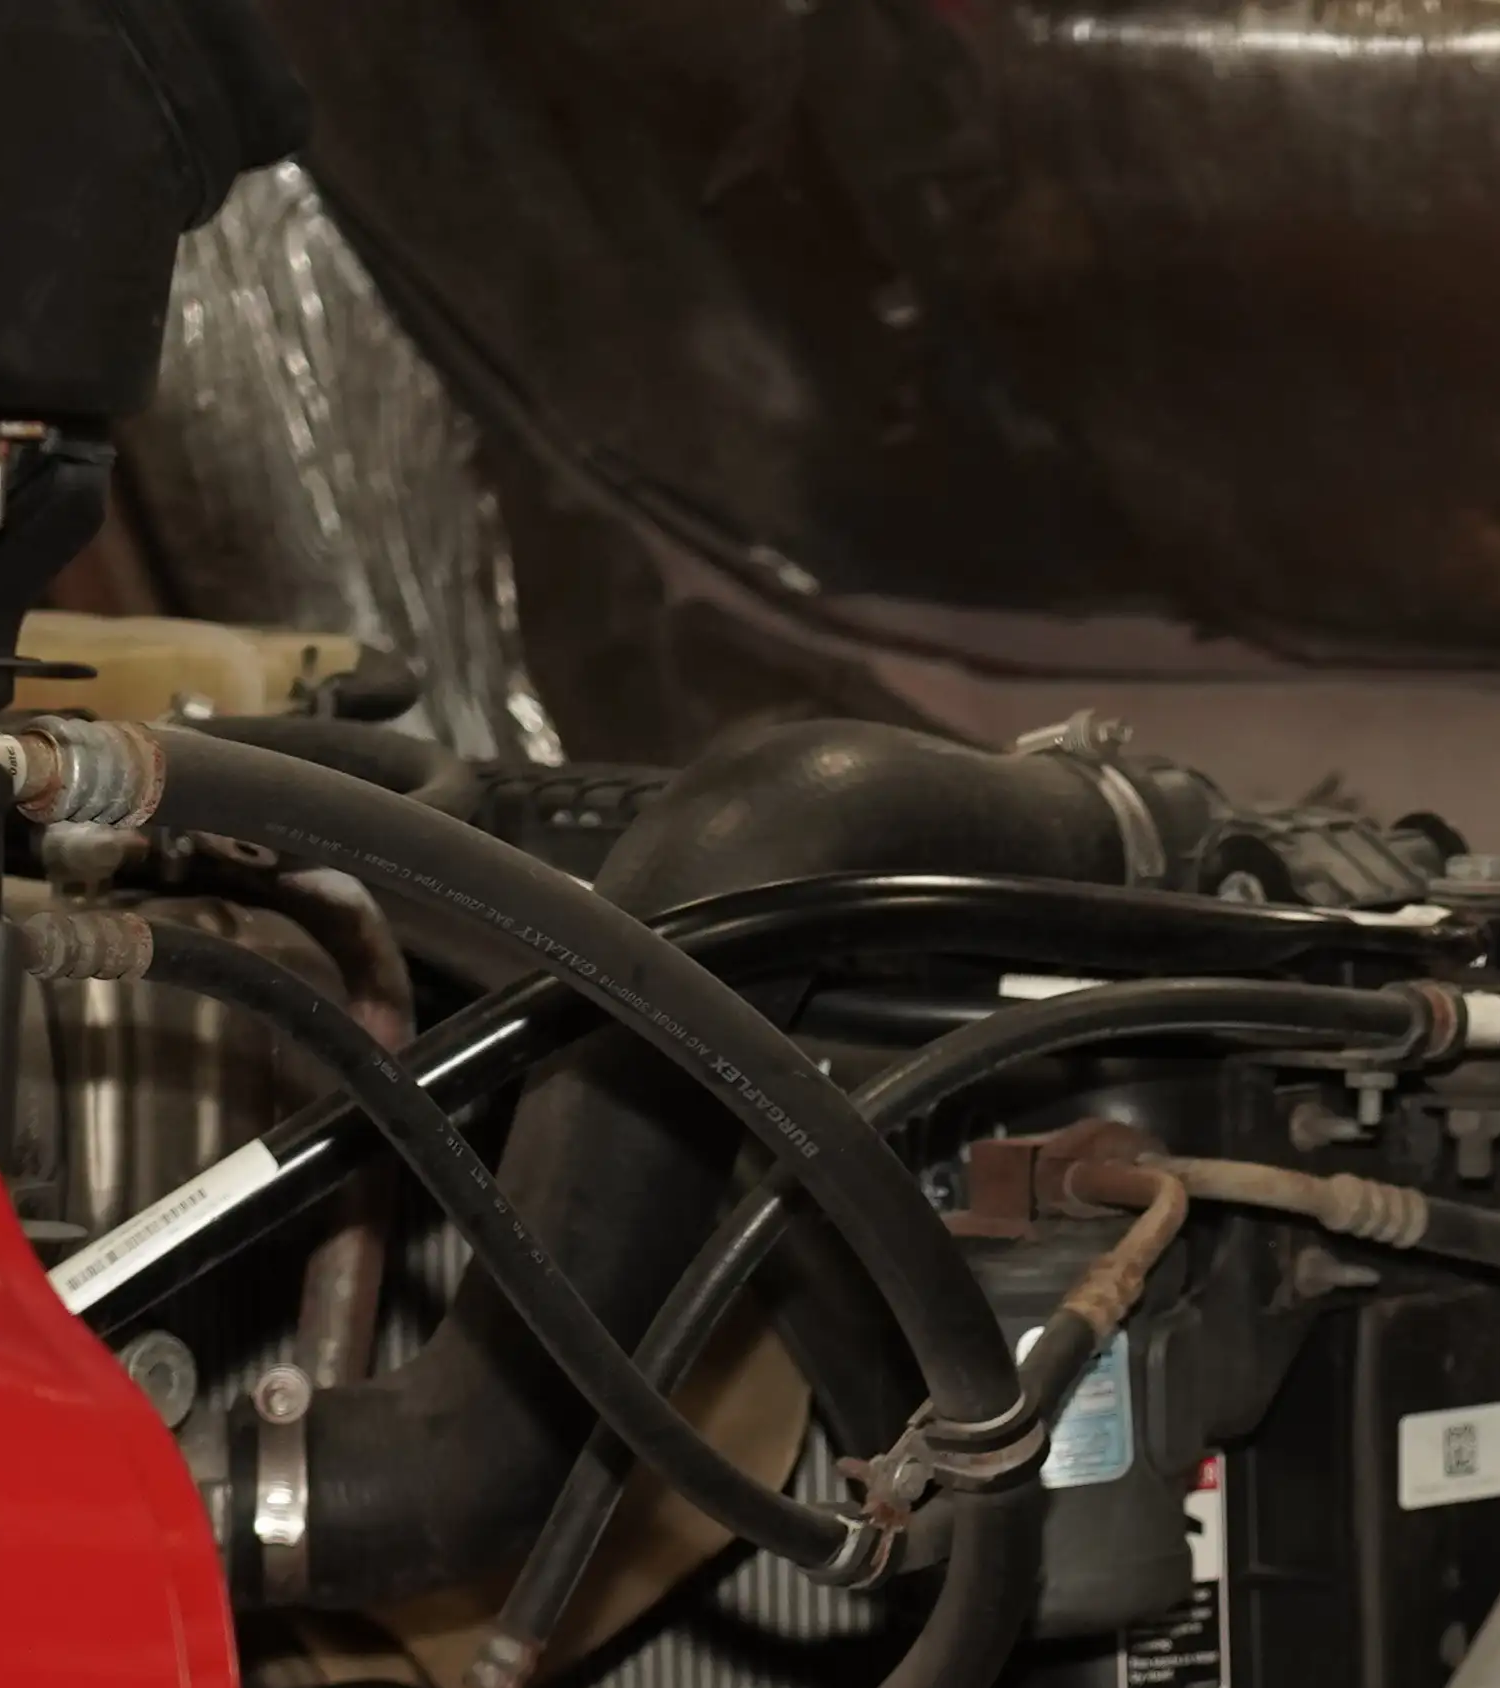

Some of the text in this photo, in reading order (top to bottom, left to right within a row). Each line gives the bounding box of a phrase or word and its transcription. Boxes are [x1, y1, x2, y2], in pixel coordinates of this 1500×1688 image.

[364, 852, 399, 874] Class
[414, 873, 445, 894] Type
[485, 907, 515, 930] SAE
[514, 925, 598, 976] GALAXY
[653, 1010, 688, 1039] HOSE
[709, 1055, 820, 1159] BURGAFLEX
